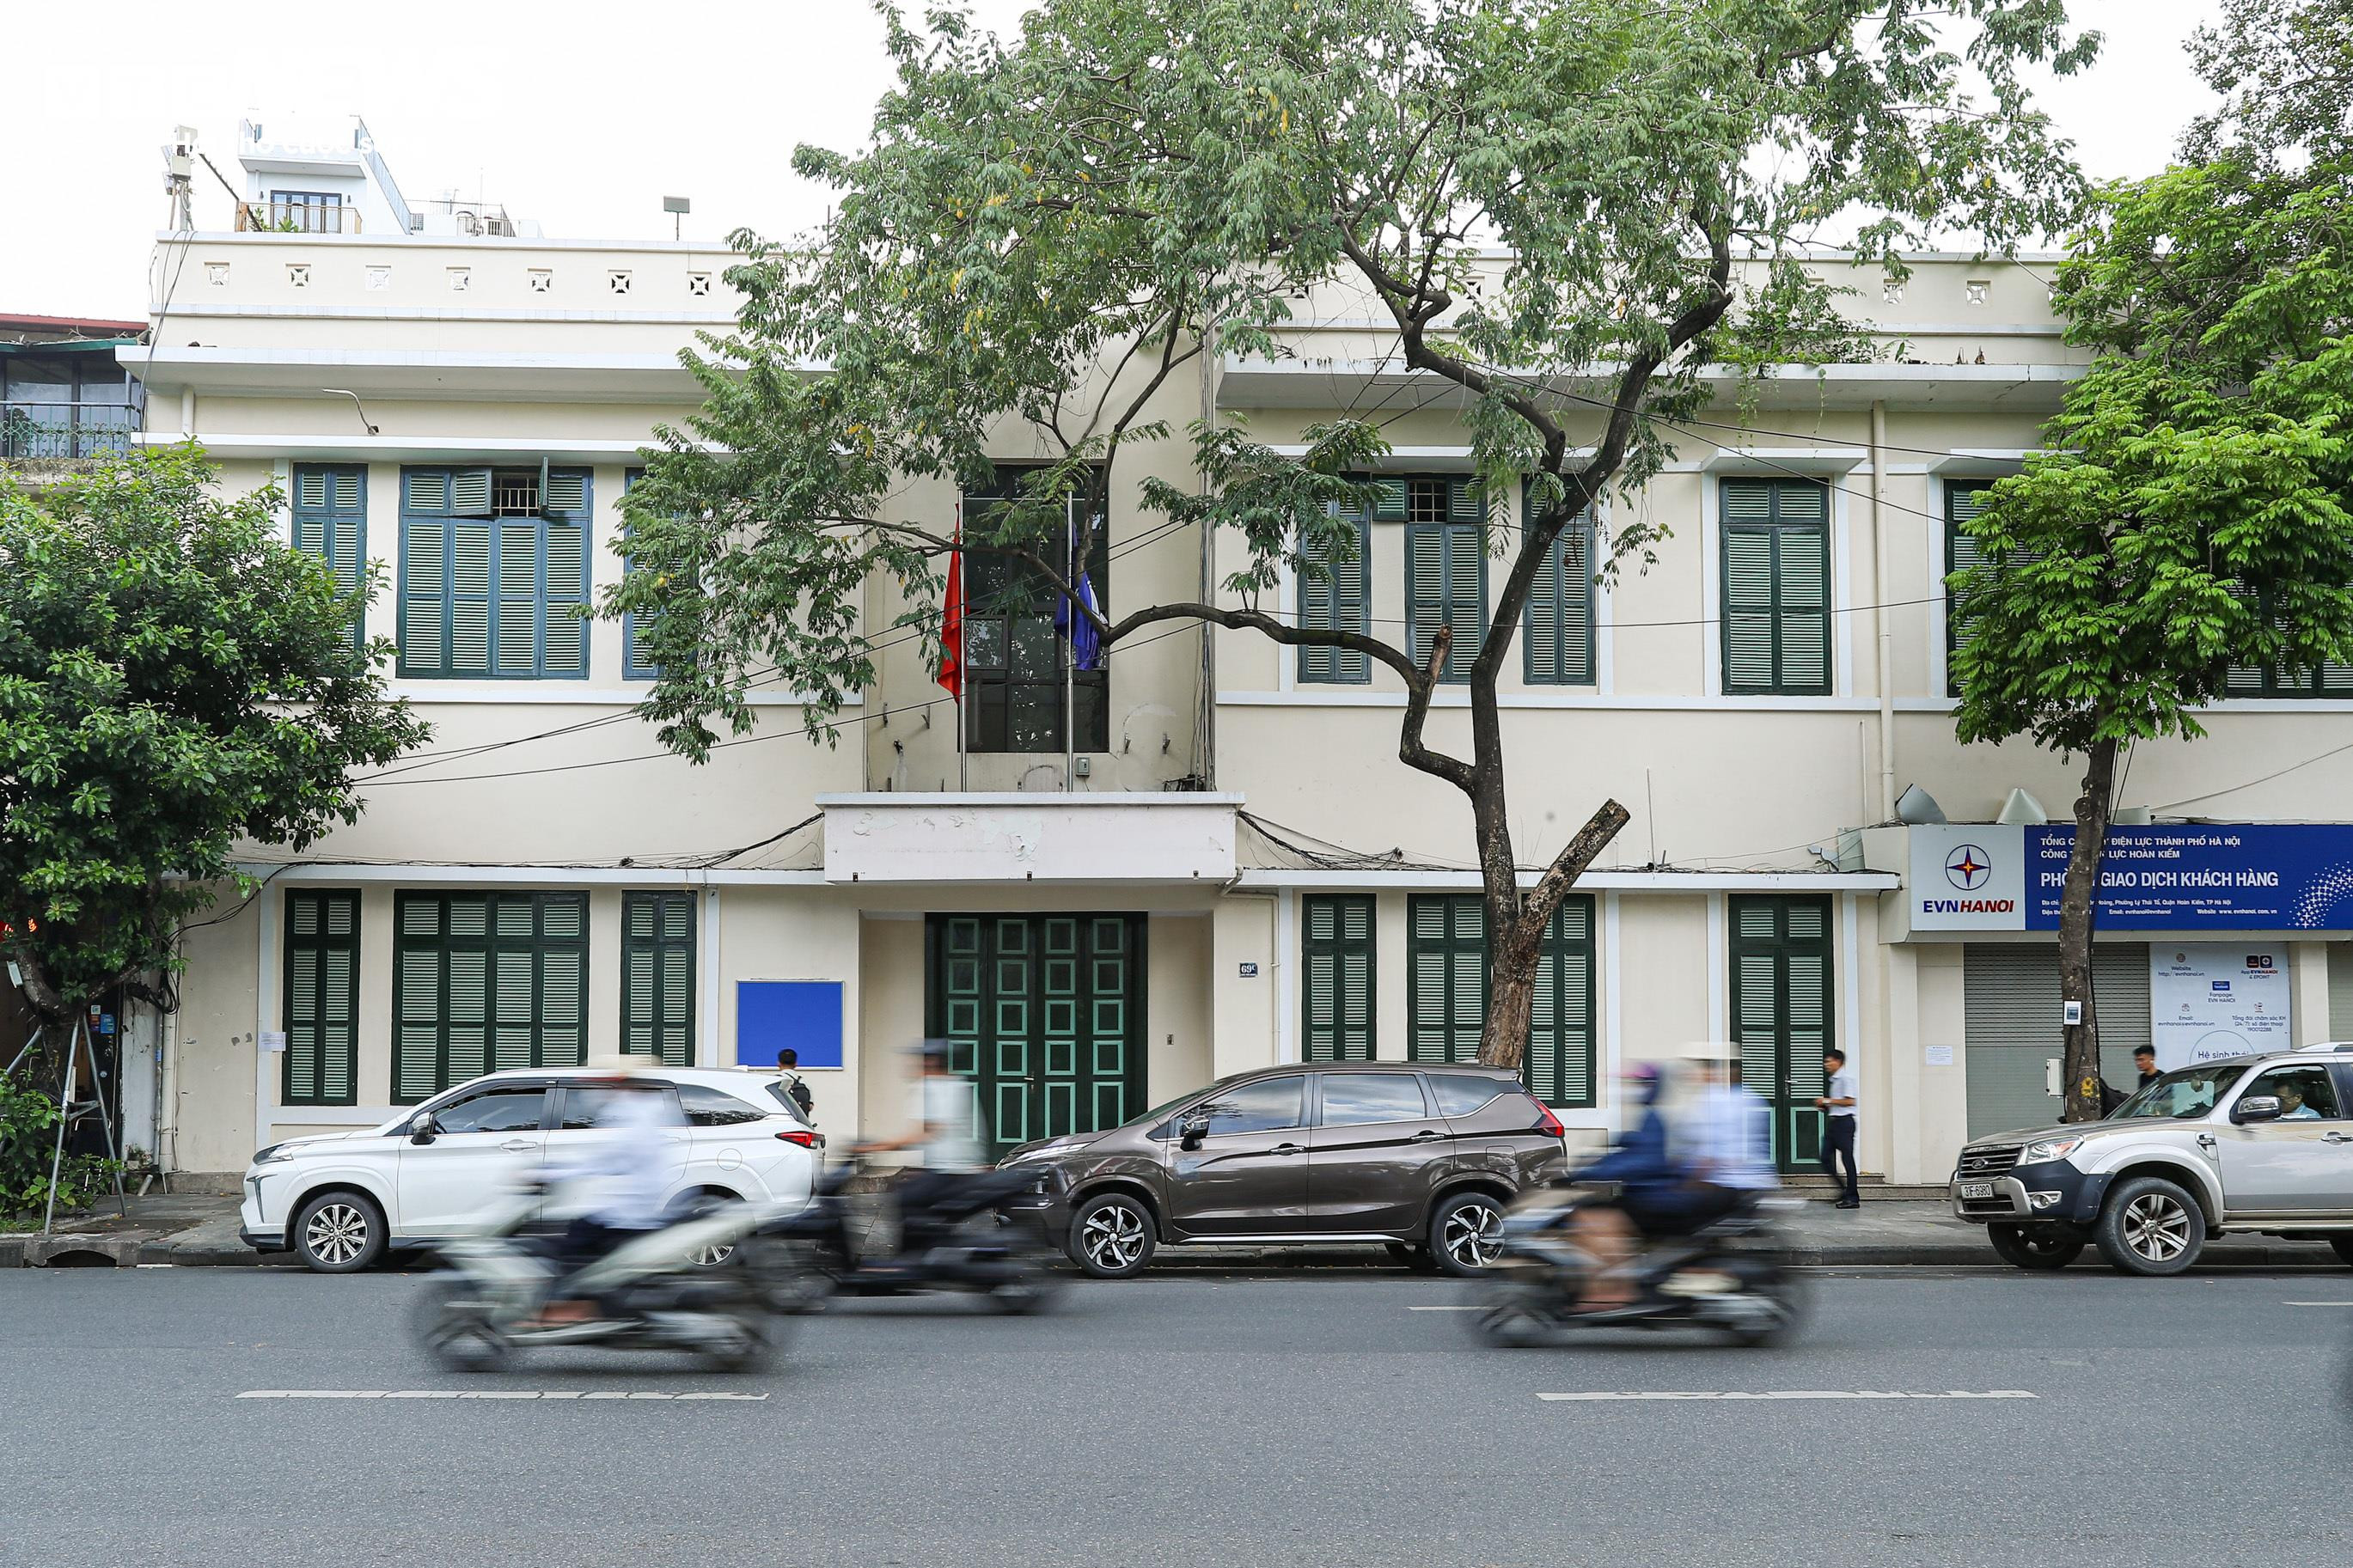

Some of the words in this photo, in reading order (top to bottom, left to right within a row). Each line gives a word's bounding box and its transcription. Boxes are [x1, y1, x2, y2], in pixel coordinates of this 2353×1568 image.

[2040, 833, 2066, 845] TỔNG
[2112, 836, 2132, 847] ĐIỆN
[2135, 838, 2152, 847] LỰC
[2154, 836, 2185, 845] THÀNH
[2187, 835, 2206, 845] PHỐ
[2209, 836, 2222, 845] HÀ
[2224, 836, 2240, 847] NỘI
[2040, 849, 2068, 858] CÔNG
[2109, 851, 2127, 860] LỰC
[2129, 849, 2155, 858] HOÀN
[2100, 872, 2137, 887] GIAO
[2141, 872, 2177, 889] DỊCH
[2181, 868, 2232, 887] KHÁCH
[2236, 868, 2279, 887] HÀNG
[2197, 1051, 2210, 1060] Hệ
